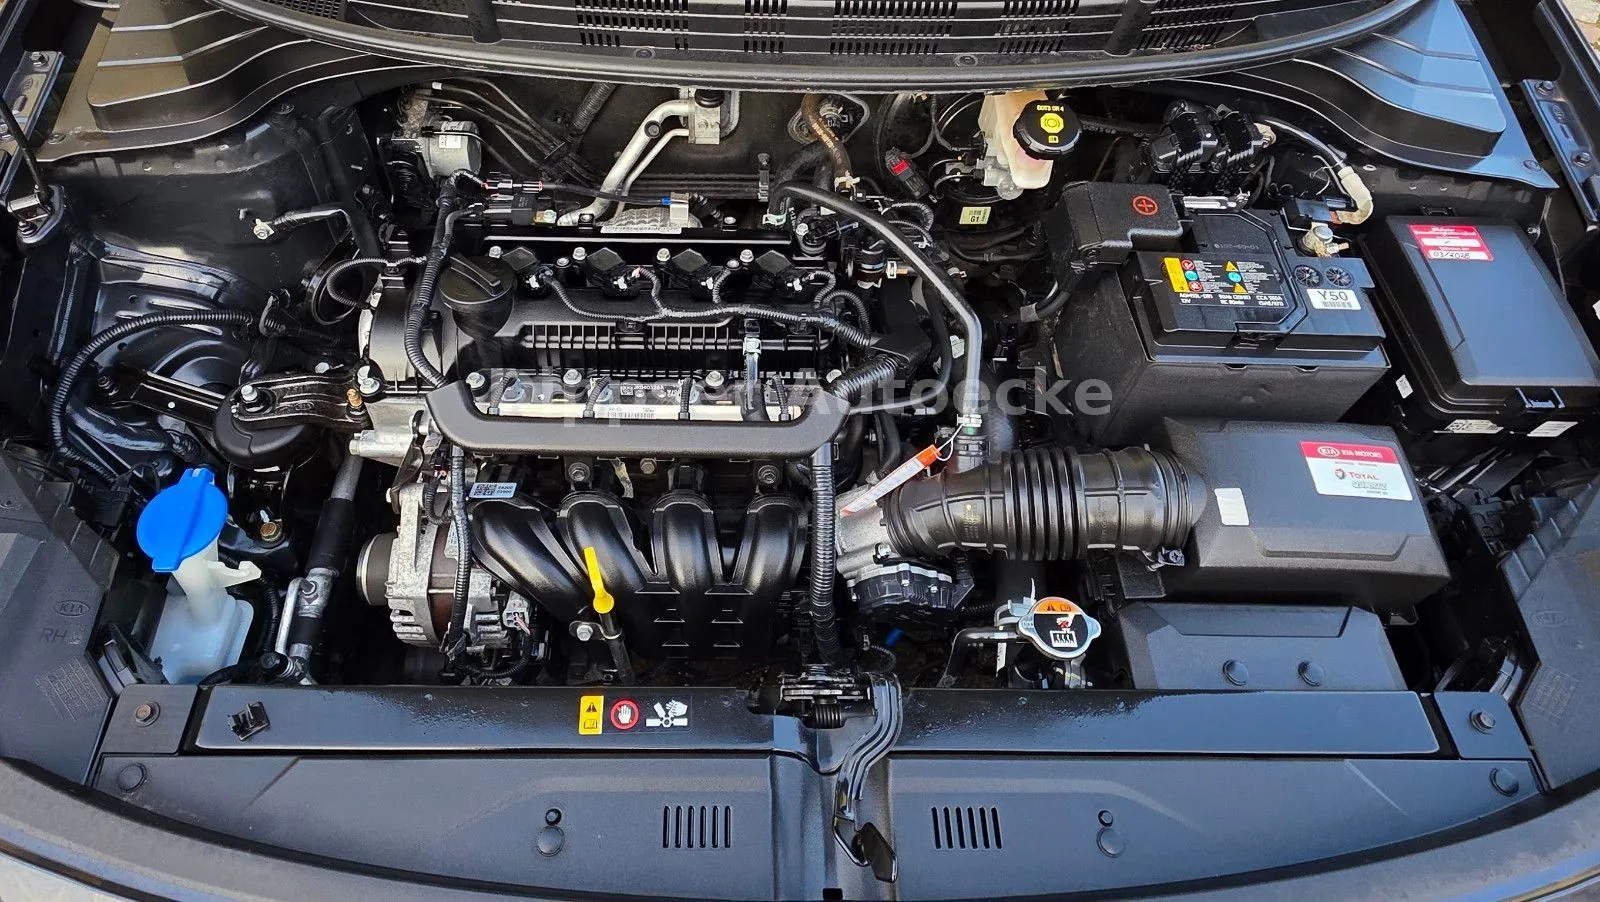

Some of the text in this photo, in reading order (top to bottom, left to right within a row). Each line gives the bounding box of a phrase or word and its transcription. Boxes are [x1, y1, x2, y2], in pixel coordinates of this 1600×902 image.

[1316, 290, 1349, 301] Y50
[1354, 450, 1383, 458] MOTORS
[1348, 471, 1380, 480] TOTAL
[40, 627, 68, 644] RH
